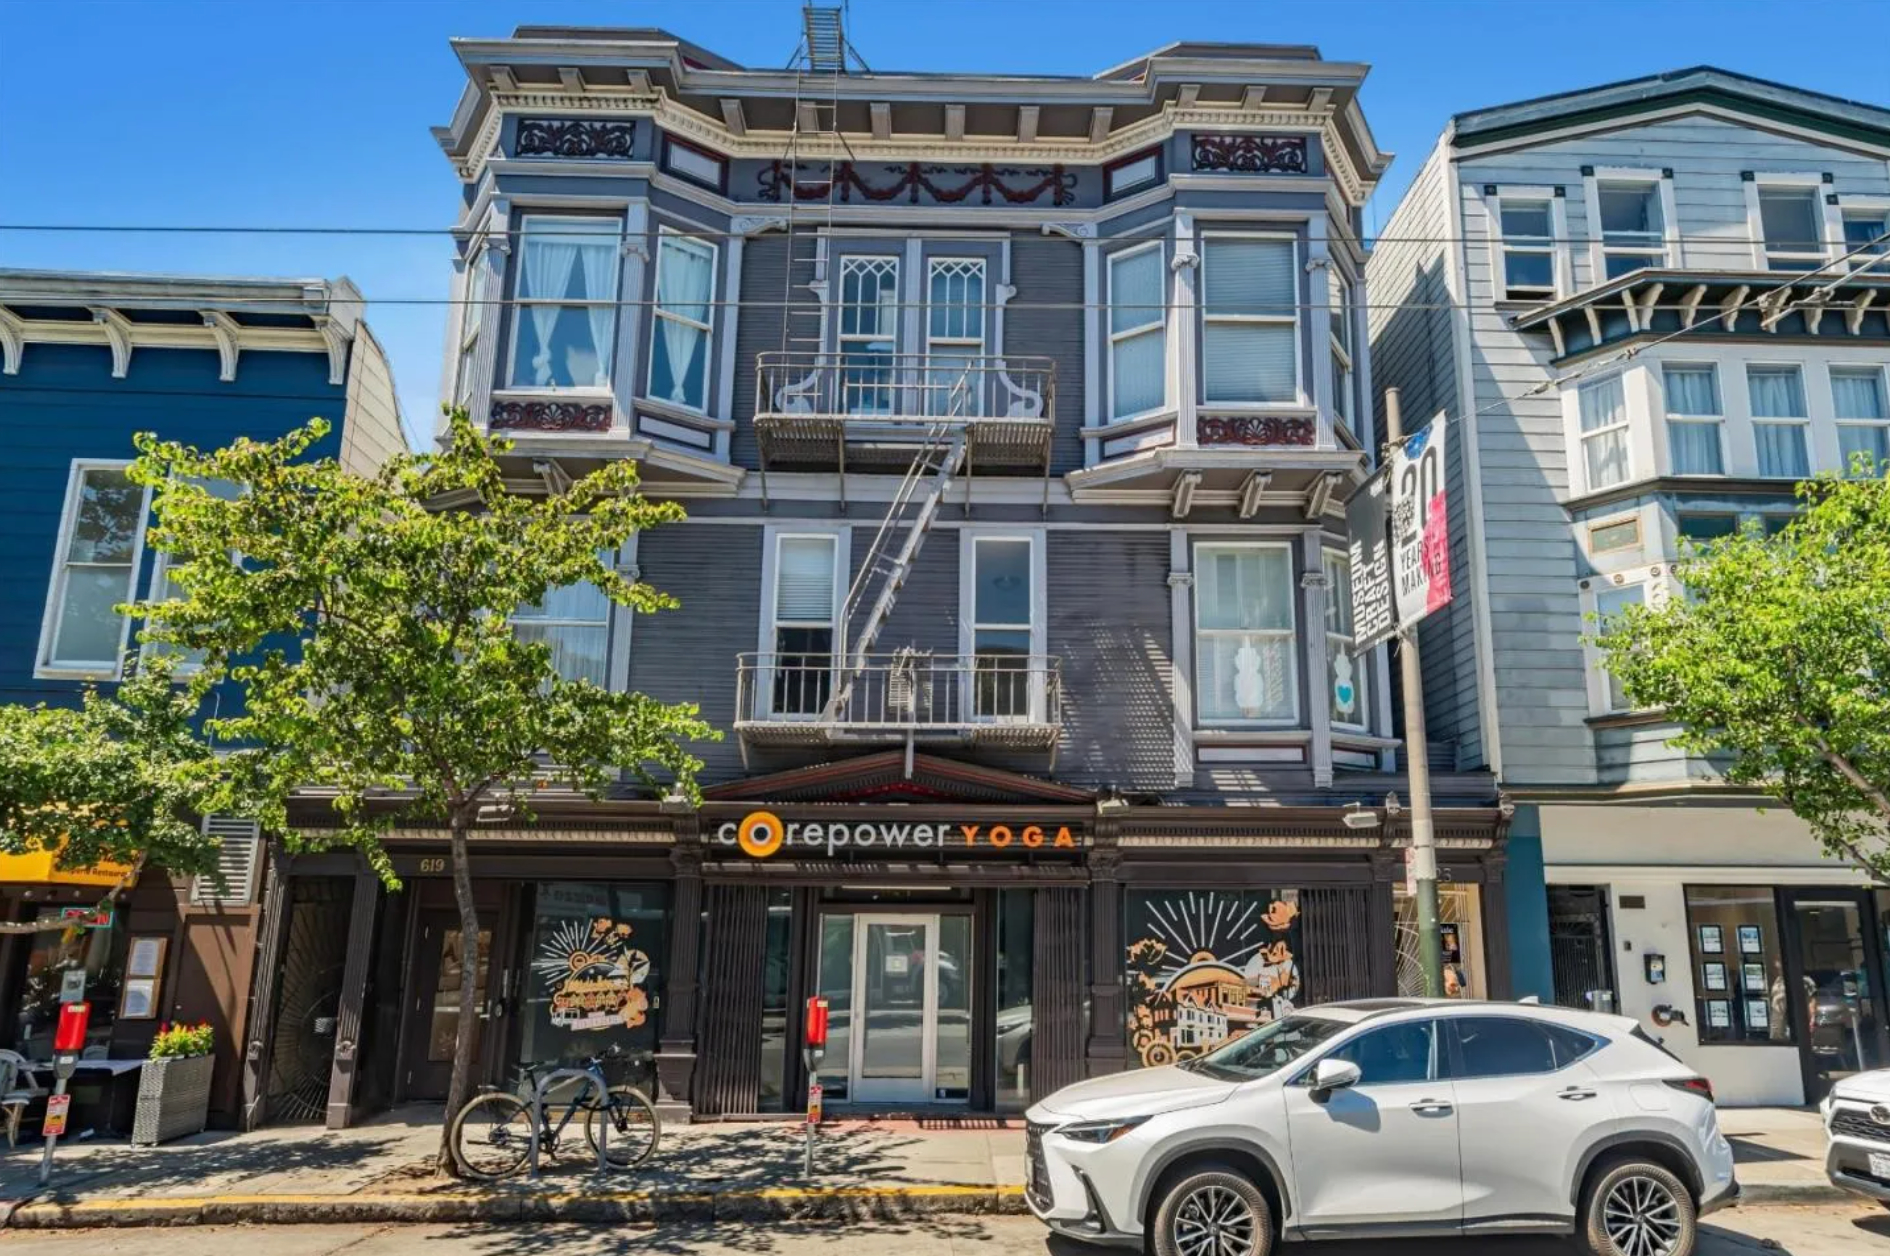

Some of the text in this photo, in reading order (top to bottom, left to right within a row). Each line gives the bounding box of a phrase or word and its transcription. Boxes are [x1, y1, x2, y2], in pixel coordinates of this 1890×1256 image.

[1402, 446, 1437, 547] 20
[1373, 538, 1392, 629] DESIGN
[1401, 538, 1429, 572] YEARS
[1402, 552, 1441, 596] MAKING
[1351, 540, 1367, 646] MUSEUM
[1363, 561, 1379, 637] CRAFT
[717, 811, 1076, 857] corepower YOGA
[420, 858, 445, 872] 619
